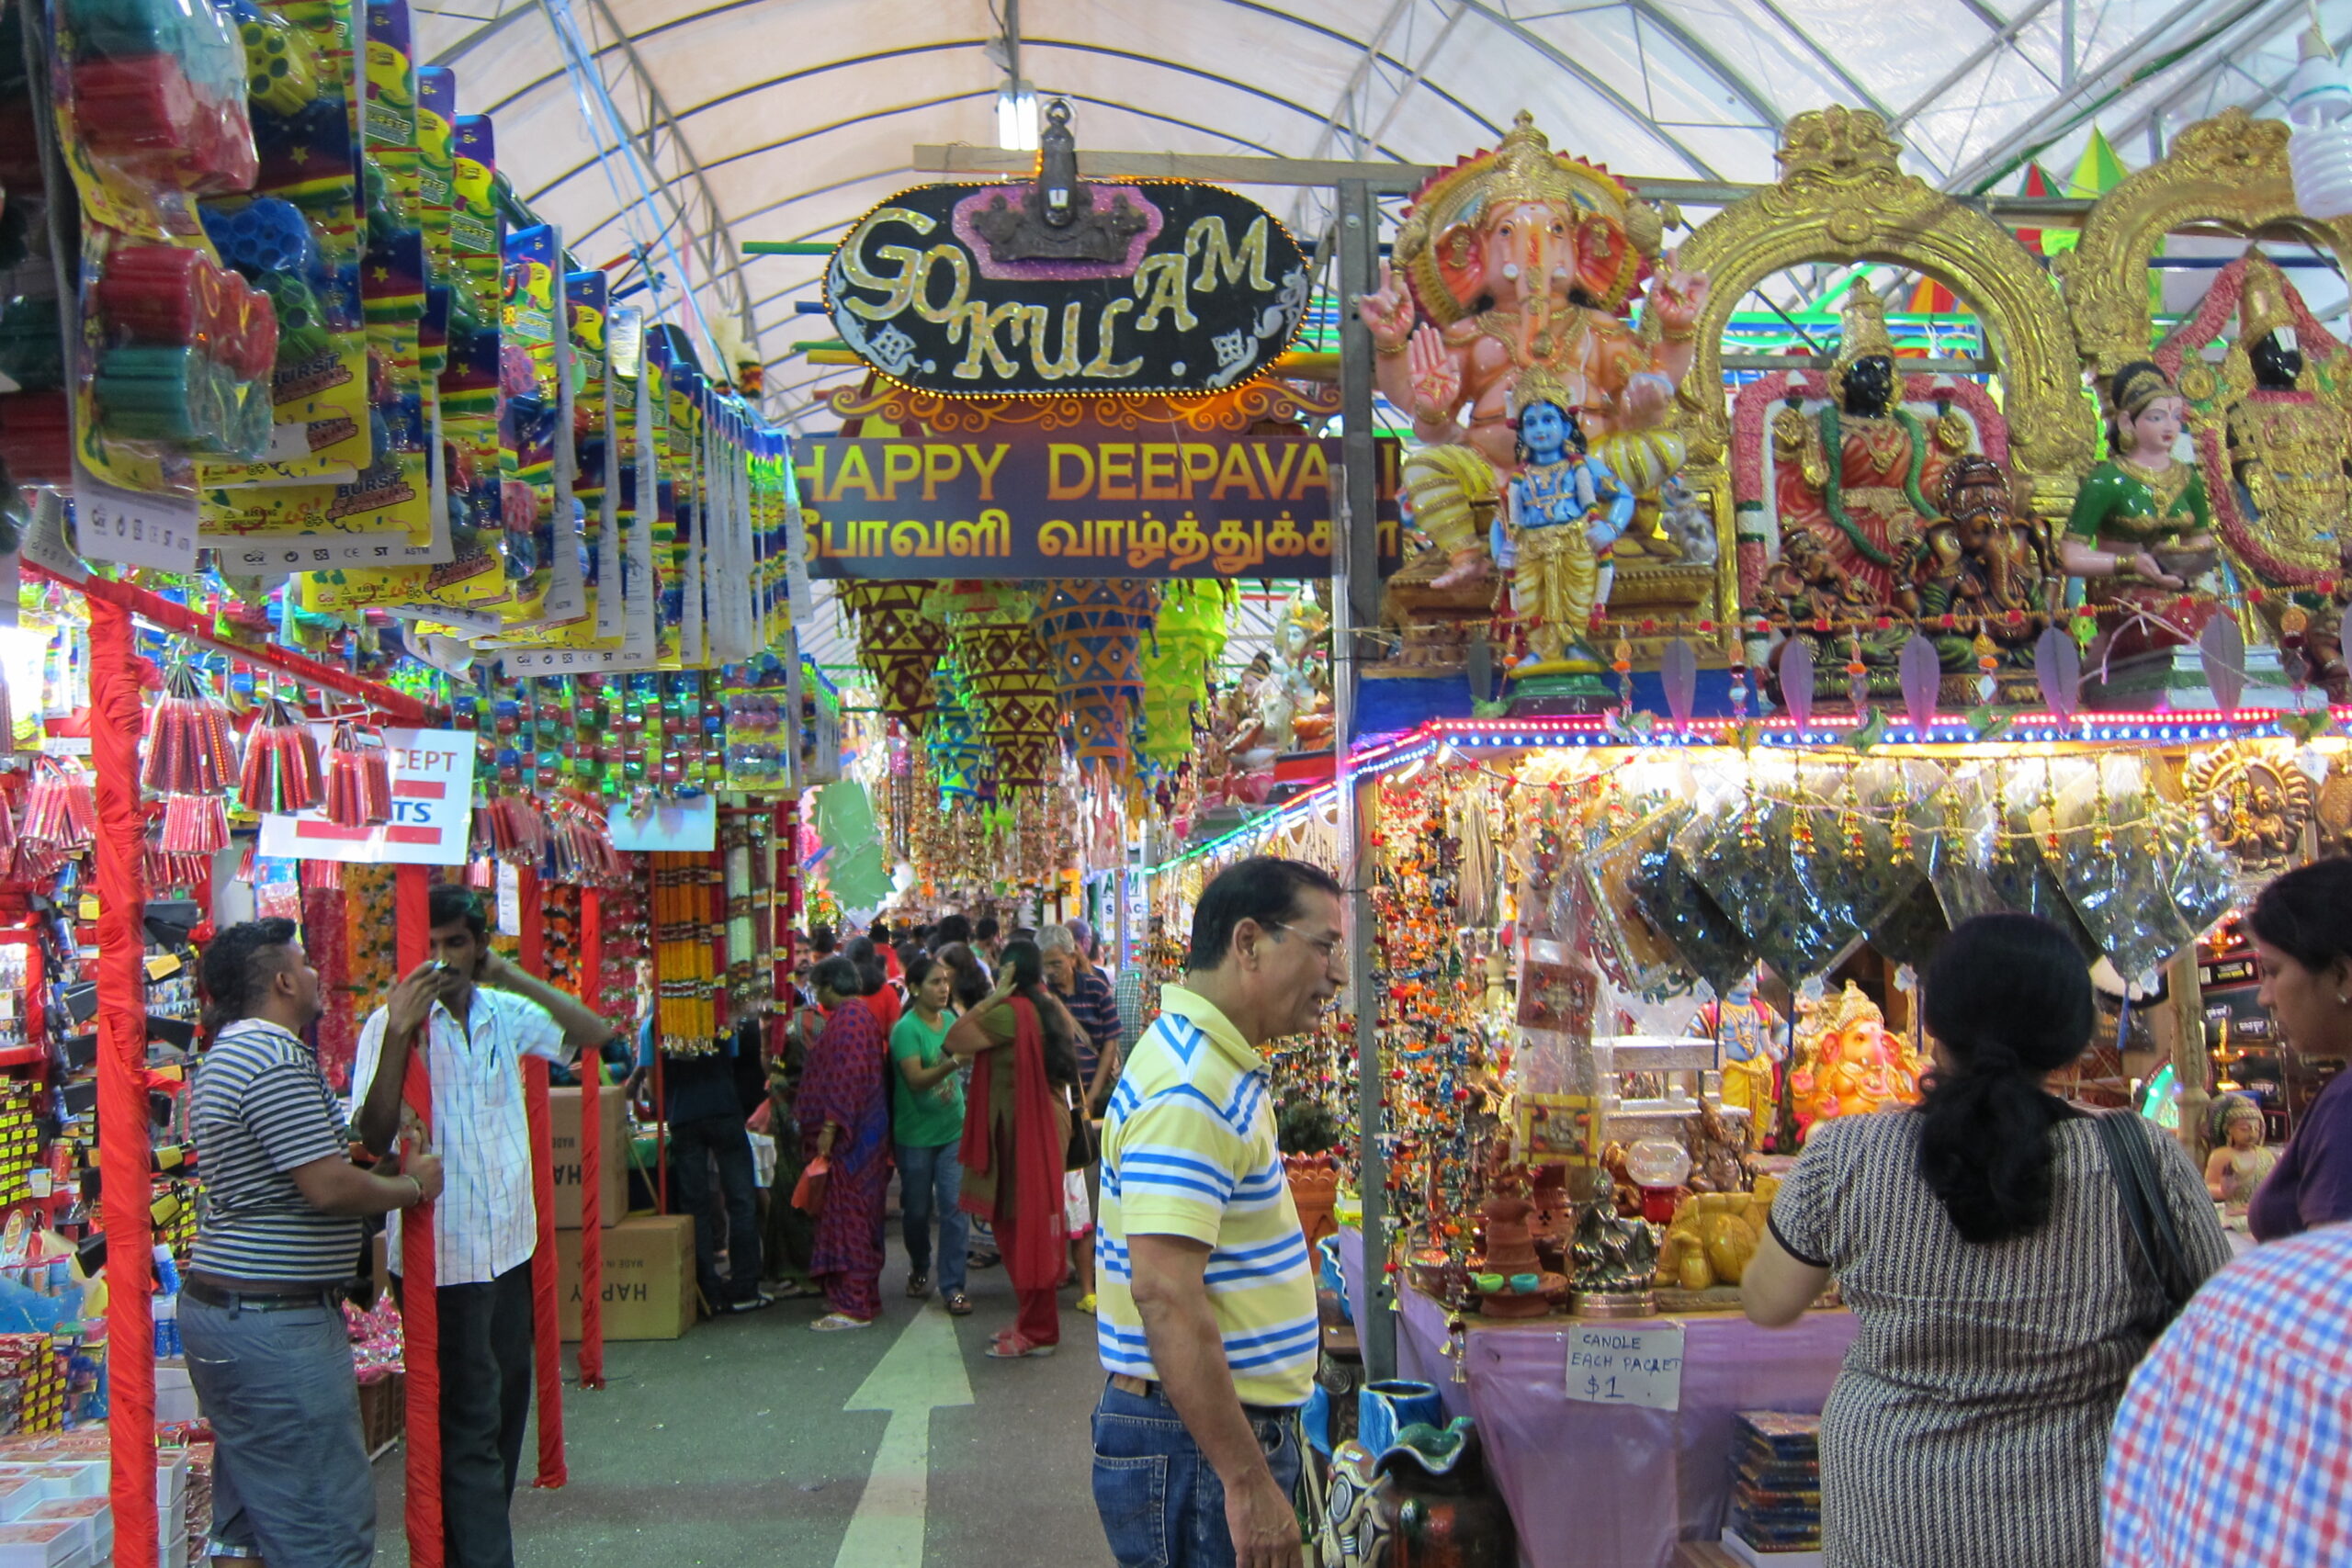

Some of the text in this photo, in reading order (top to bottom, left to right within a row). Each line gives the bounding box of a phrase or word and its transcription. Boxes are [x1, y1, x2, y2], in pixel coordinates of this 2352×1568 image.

[797, 443, 1396, 502] HAPPY DEEPAVAI
[570, 1283, 648, 1303] HAPY
[1583, 1334, 1642, 1350] CANDLE
[1571, 1351, 1613, 1369] EACH
[1584, 1374, 1625, 1401] $1
